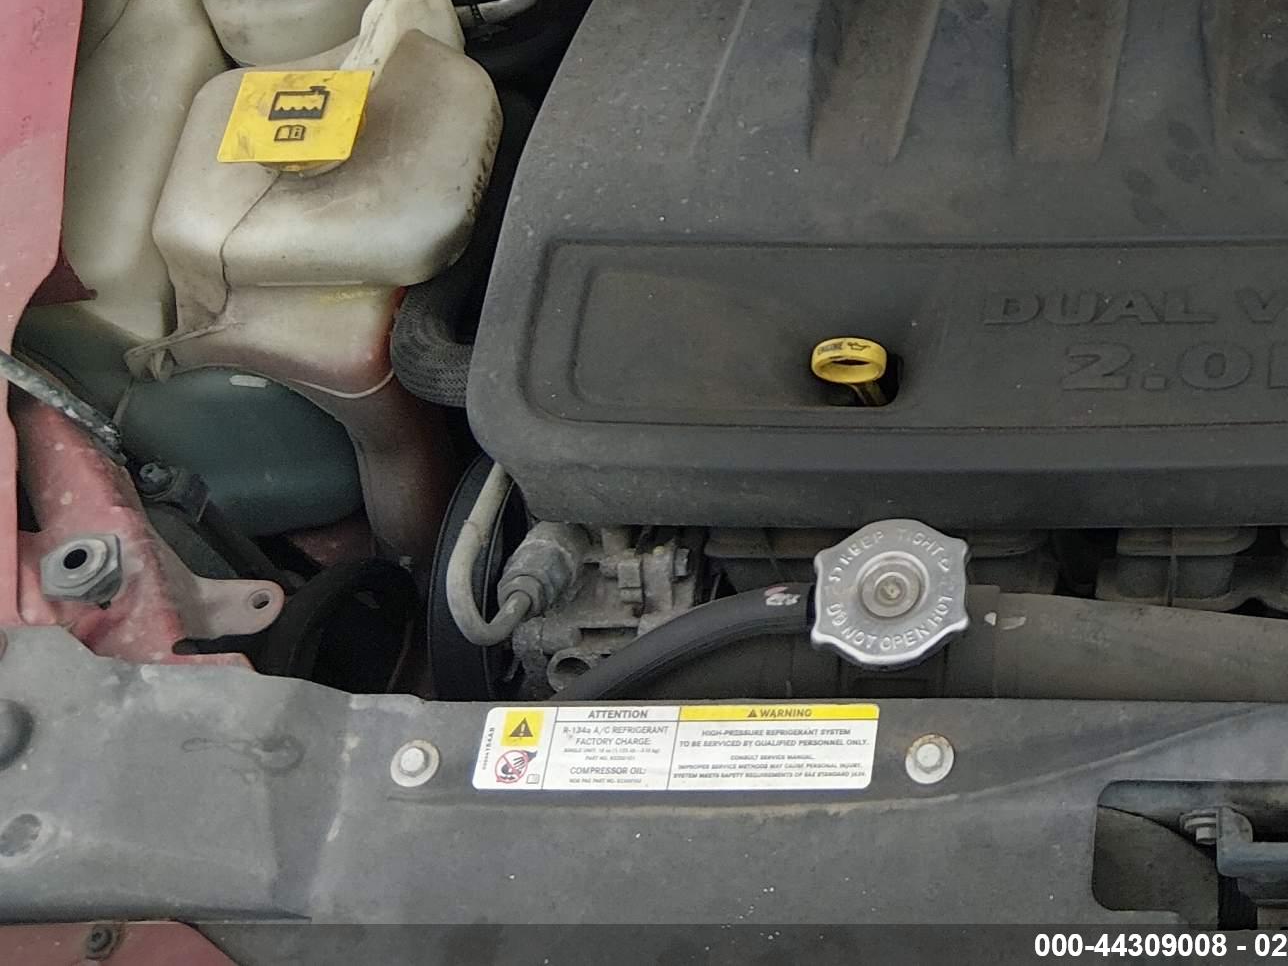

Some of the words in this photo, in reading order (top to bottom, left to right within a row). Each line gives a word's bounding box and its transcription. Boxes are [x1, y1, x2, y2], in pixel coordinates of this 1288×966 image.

[983, 289, 1216, 326] DUAL
[841, 625, 875, 649] NOT
[879, 622, 930, 651] OPEN
[588, 710, 648, 719] ATTENTION
[760, 709, 812, 718] WARNING
[593, 726, 611, 735] A/C
[613, 726, 669, 734] REFRIGERANT
[575, 737, 614, 746] FACTORY
[570, 767, 628, 775] COMPRESSOR
